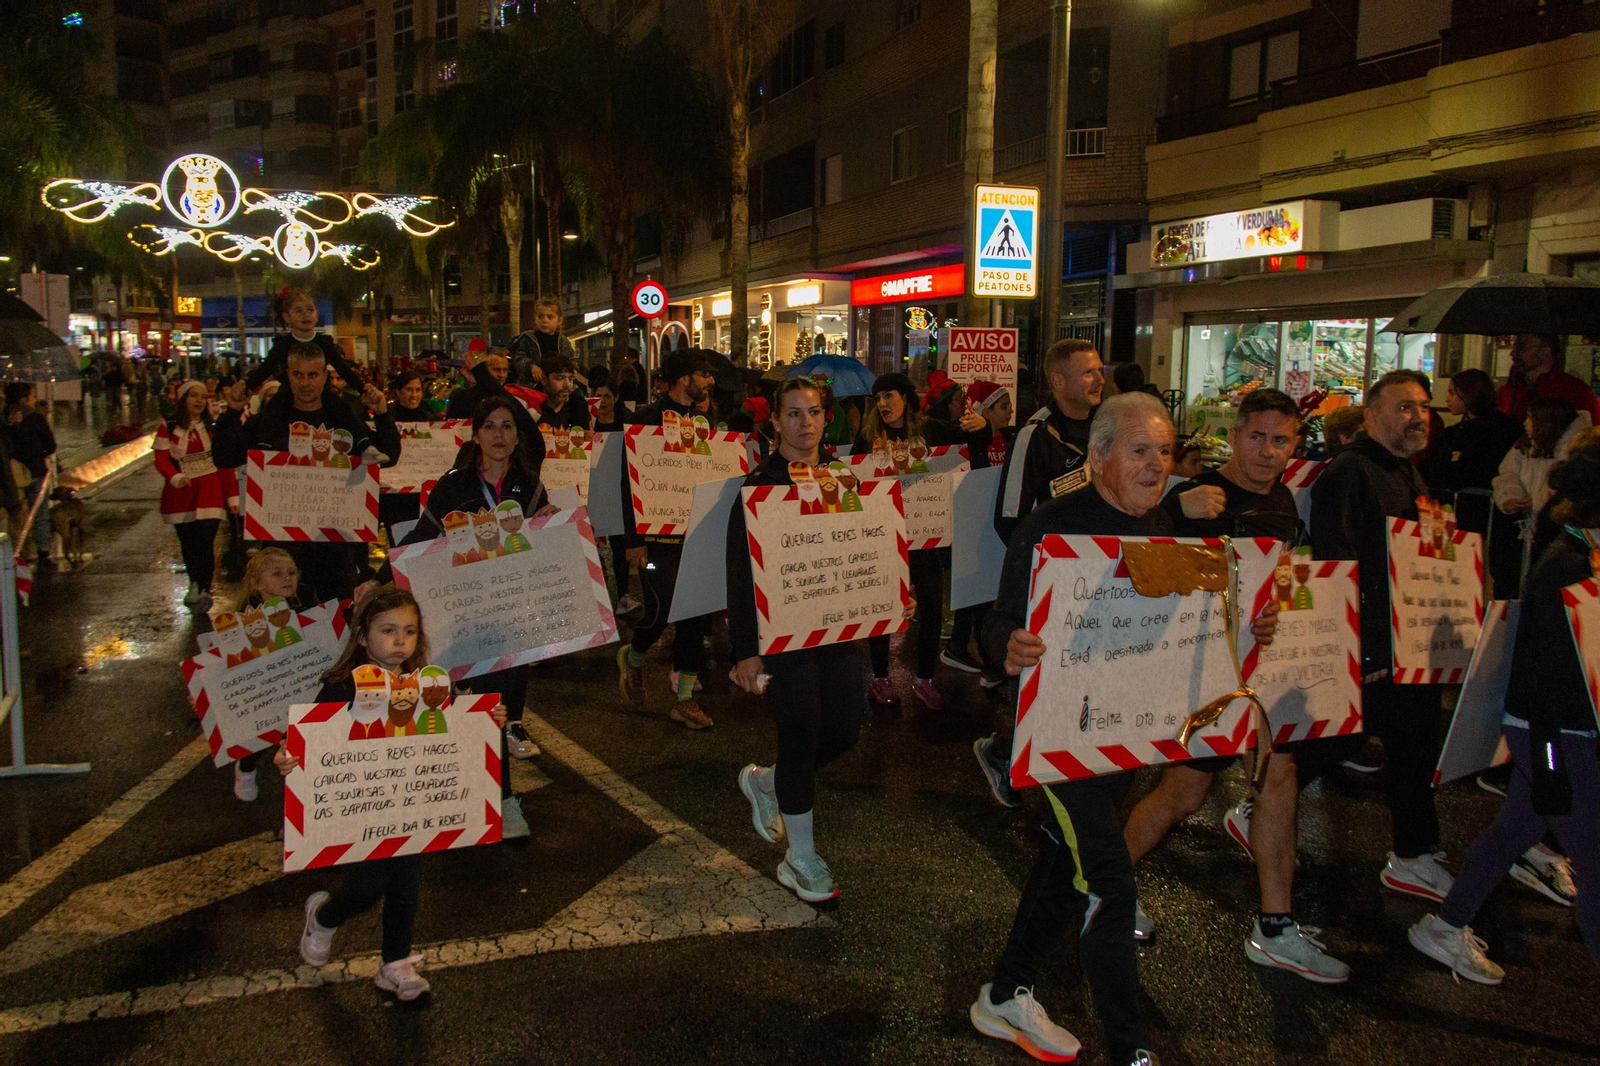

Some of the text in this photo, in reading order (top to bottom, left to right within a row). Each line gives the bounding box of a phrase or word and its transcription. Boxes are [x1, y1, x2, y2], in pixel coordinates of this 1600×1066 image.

[1195, 221, 1205, 237] DE
[1236, 215, 1242, 231] Y
[1242, 208, 1285, 230] VERDURAS
[887, 275, 933, 296] MAPFRE
[982, 271, 1028, 281] PASO DE
[978, 282, 1032, 292] PEATONES
[641, 293, 660, 305] 30
[952, 332, 1014, 350] AVISO
[952, 364, 1013, 373] DEPORTIVA
[960, 354, 1005, 363] PRUEBA
[272, 483, 298, 493] PIDO
[279, 494, 346, 506] Y LLEGAR SIN
[317, 516, 326, 526] DE
[648, 507, 675, 517] NUNCA
[780, 532, 824, 549] QUERIDOS
[831, 529, 857, 542] REYES
[780, 562, 807, 576] CARGAD
[847, 551, 879, 564] CAMELLOS
[428, 580, 484, 600] QUERIDOS
[491, 571, 523, 585] REYES
[782, 579, 793, 590] DE
[795, 574, 827, 587] SONRISAS
[832, 571, 839, 581] Y
[1072, 577, 1136, 601] Queridos
[444, 594, 483, 612] CARGAD
[528, 576, 570, 592] CAMELLOS
[783, 594, 798, 605] LAS
[802, 586, 839, 600] ZAPATILLAS
[843, 582, 854, 593] DE
[454, 613, 470, 624] DE
[475, 600, 523, 619] SONRISAS
[525, 597, 532, 606] Y
[860, 606, 870, 616] DE
[1179, 611, 1194, 624] en
[1199, 609, 1209, 623] la
[451, 628, 470, 639] LAS
[474, 615, 525, 635] ZAPATILLAS
[527, 612, 538, 622] DE
[531, 626, 543, 635] DE
[1060, 646, 1091, 668] Está
[1161, 640, 1169, 651] a
[220, 668, 265, 690] QUERIDOS
[265, 657, 292, 672] REYES
[223, 683, 256, 702] CARGAD
[297, 654, 333, 672] CAMELLOS
[228, 702, 240, 712] DE
[243, 686, 278, 706] SONRISAS
[281, 682, 287, 690] Y
[236, 708, 251, 719] LAS
[253, 691, 292, 713] ZAPATILLAS
[293, 687, 302, 697] DE
[1164, 711, 1177, 725] de
[321, 751, 379, 767] QUERIDOS
[386, 746, 416, 760] REYES
[313, 762, 460, 788] CARGAD VUESTROS CAMELLOS
[314, 776, 458, 804] DE SONRISAS Y LLENADNOS
[314, 807, 333, 820] LAS
[341, 799, 395, 817] ZAPATILLAS
[403, 796, 416, 807] DE
[362, 823, 397, 841] ¡FELIZ
[423, 818, 434, 829] DE
[439, 813, 467, 828] REYES!
